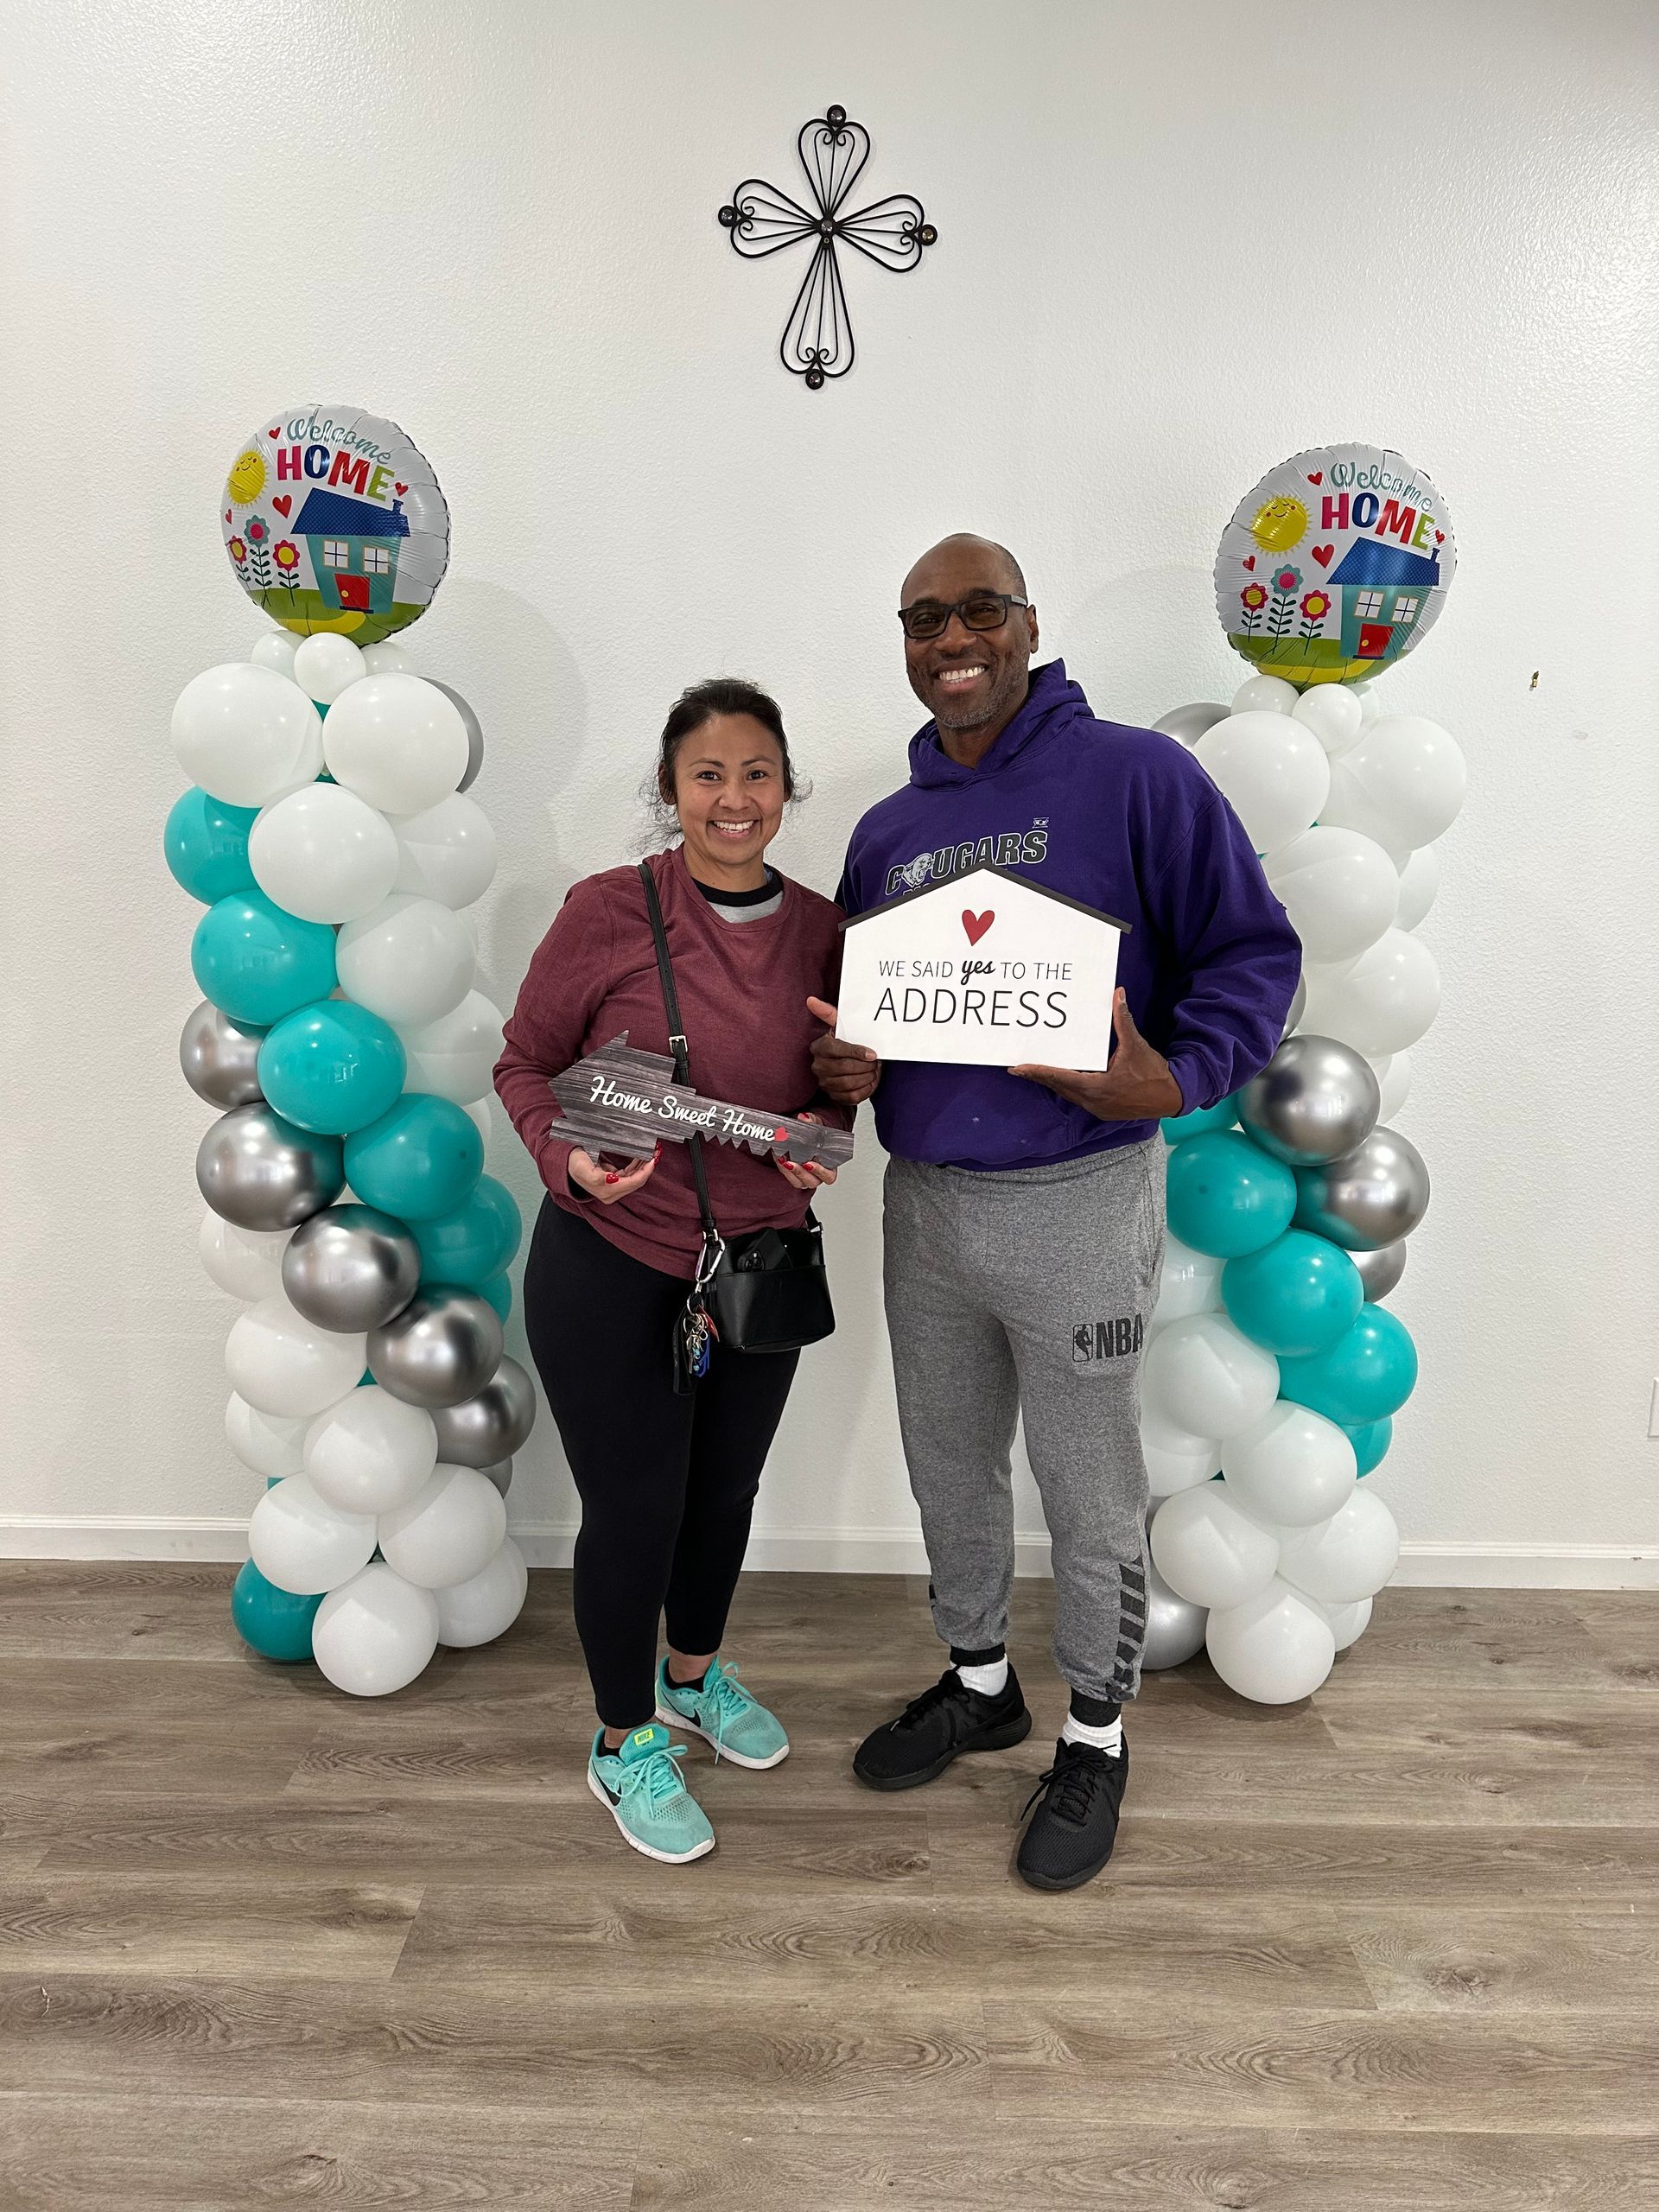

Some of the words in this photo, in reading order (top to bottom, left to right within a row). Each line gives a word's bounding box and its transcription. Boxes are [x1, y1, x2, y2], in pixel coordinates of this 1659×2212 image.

[287, 416, 391, 465] Welcome
[277, 444, 395, 501] HOME
[1330, 462, 1433, 512] Welcome
[1321, 492, 1435, 550] HOME
[886, 830, 1048, 895] CUGARS
[879, 960, 906, 977] WE
[912, 961, 953, 978] SAID
[960, 960, 995, 985] yes
[1001, 962, 1026, 979] TO
[1033, 963, 1073, 981] THE
[873, 988, 1068, 1028] ADDRESS
[589, 1076, 652, 1114] Home
[658, 1095, 717, 1128] Sweet
[722, 1109, 774, 1142] Home
[1096, 1313, 1143, 1359] NBA
